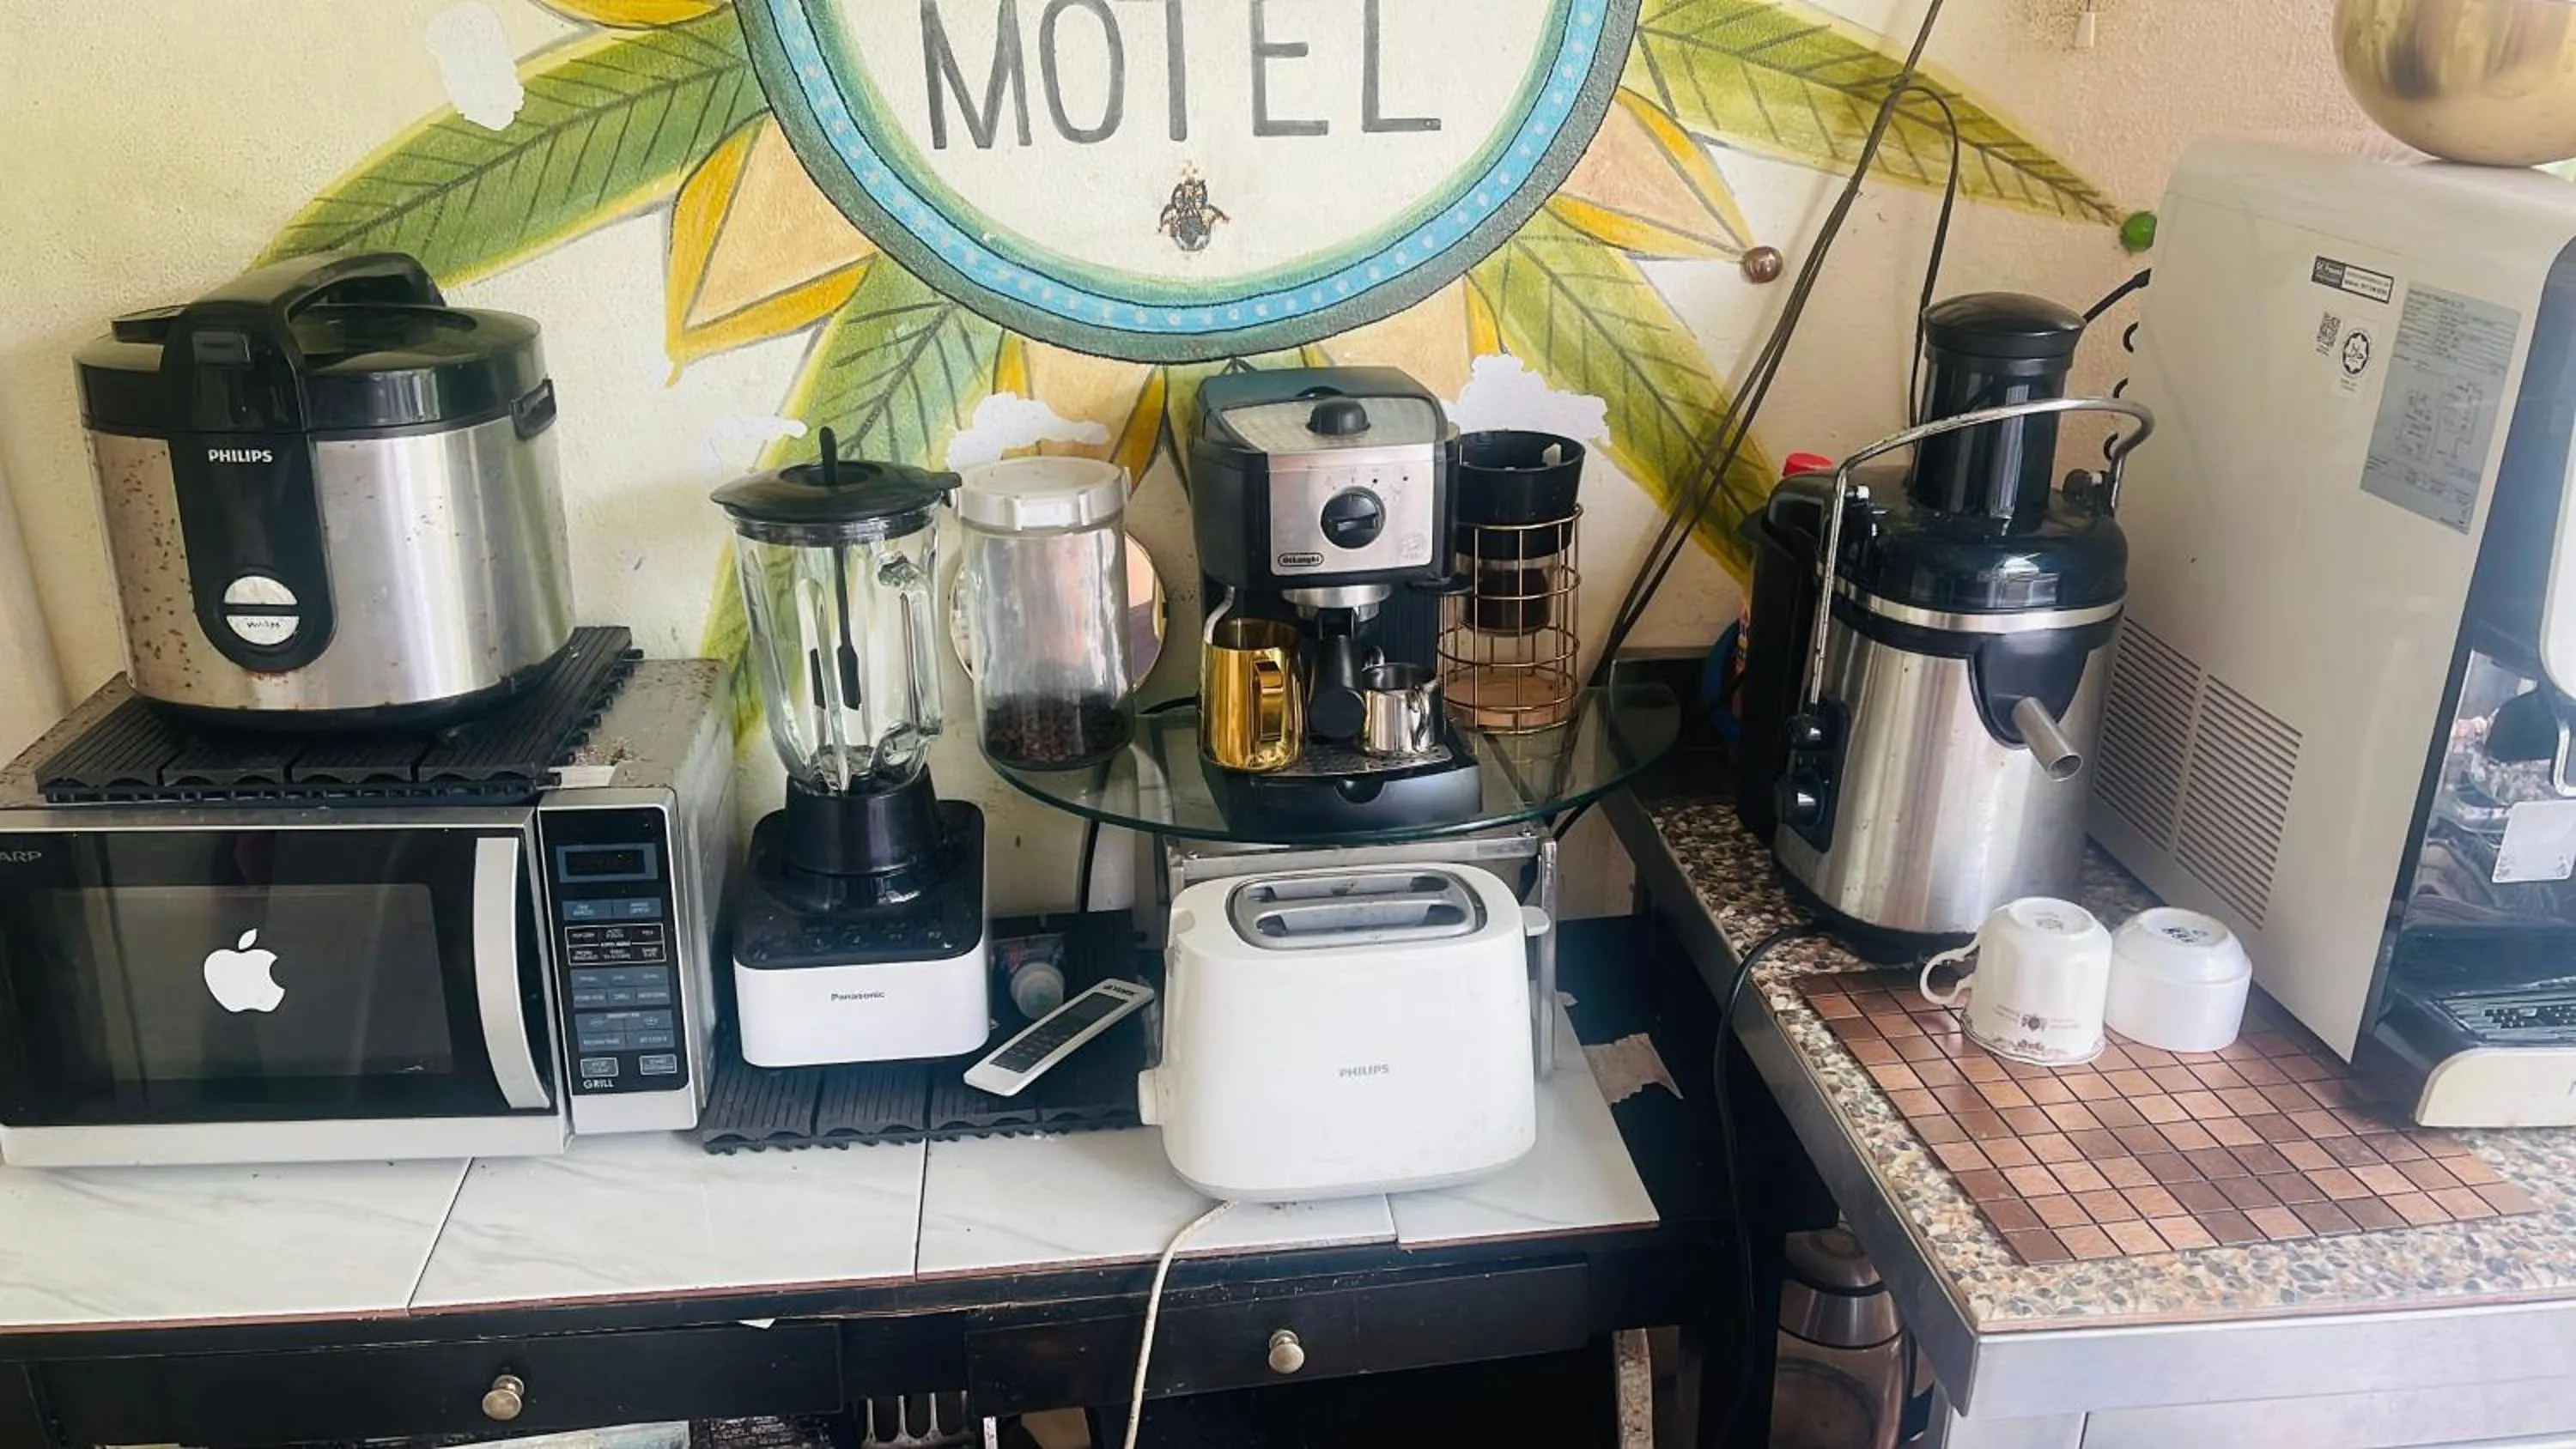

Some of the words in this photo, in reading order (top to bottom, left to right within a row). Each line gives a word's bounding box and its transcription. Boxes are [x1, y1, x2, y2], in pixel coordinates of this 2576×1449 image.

[920, 0, 1442, 149] MOTEL
[208, 449, 273, 463] PHILIPS
[830, 991, 885, 1002] Panasonic
[1339, 1064, 1389, 1079] PHILIPS
[583, 1078, 615, 1089] GRILL
